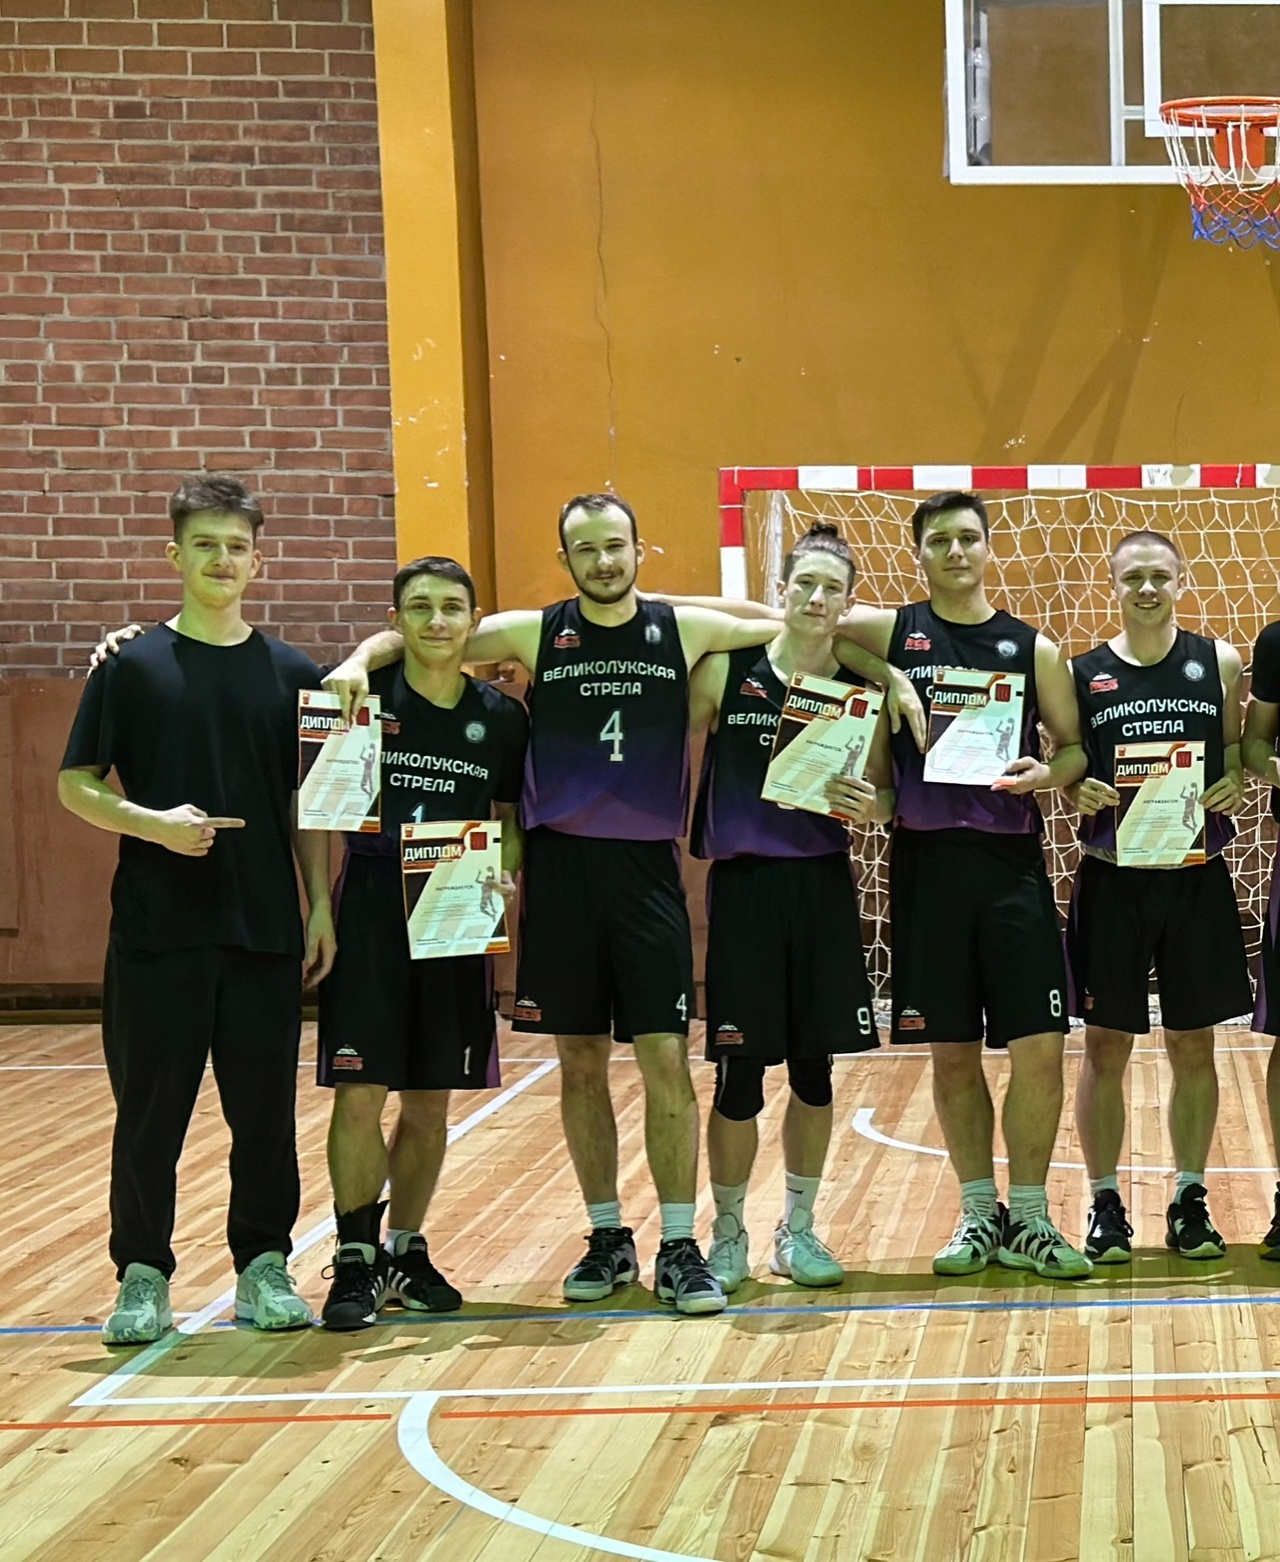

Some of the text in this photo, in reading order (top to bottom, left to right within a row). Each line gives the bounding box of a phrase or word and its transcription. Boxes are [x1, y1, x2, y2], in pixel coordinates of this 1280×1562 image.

[542, 660, 677, 682] ВЕЛИКОЛУКСКАЯ
[579, 682, 642, 696] СТРЕЛА
[933, 690, 988, 706] ДИПЛОМ
[786, 695, 843, 719] ДИПЛОМ
[1090, 698, 1217, 729] ВЕЛИКОЛУКСКАЯ
[600, 710, 624, 762] 4
[1122, 720, 1184, 737] СТРЕЛА
[1116, 763, 1169, 777] ДИПЛОМ
[389, 773, 456, 793] СТРЕЛА
[403, 845, 461, 861] ДИПЛОМ
[676, 993, 687, 1021] 4
[1049, 989, 1062, 1017] 8
[857, 1007, 871, 1034] 9
